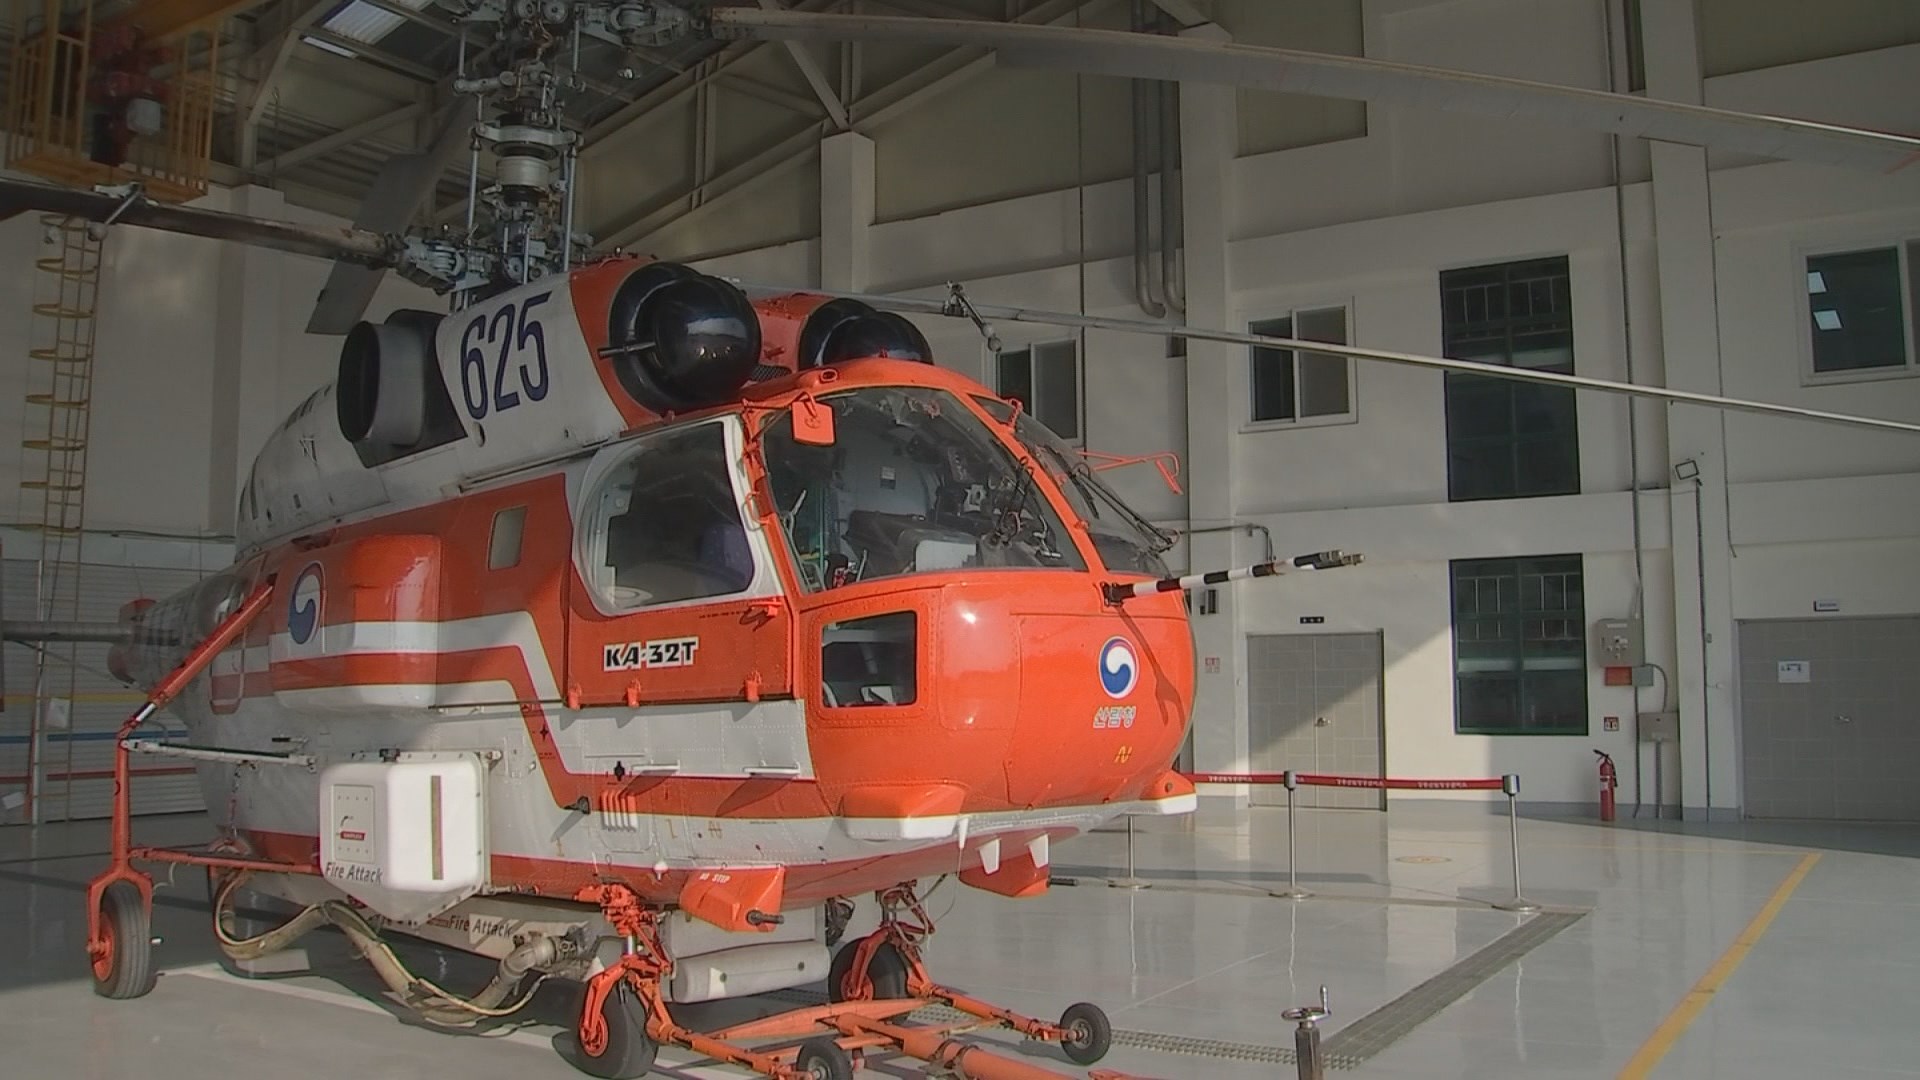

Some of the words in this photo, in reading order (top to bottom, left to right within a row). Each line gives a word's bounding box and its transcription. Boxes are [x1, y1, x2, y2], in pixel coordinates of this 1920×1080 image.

[461, 290, 552, 420] 625
[605, 639, 698, 669] KA-32T
[325, 861, 345, 879] Fire
[346, 864, 384, 884] Attack
[450, 914, 470, 932] Fire
[472, 918, 513, 938] Attack
